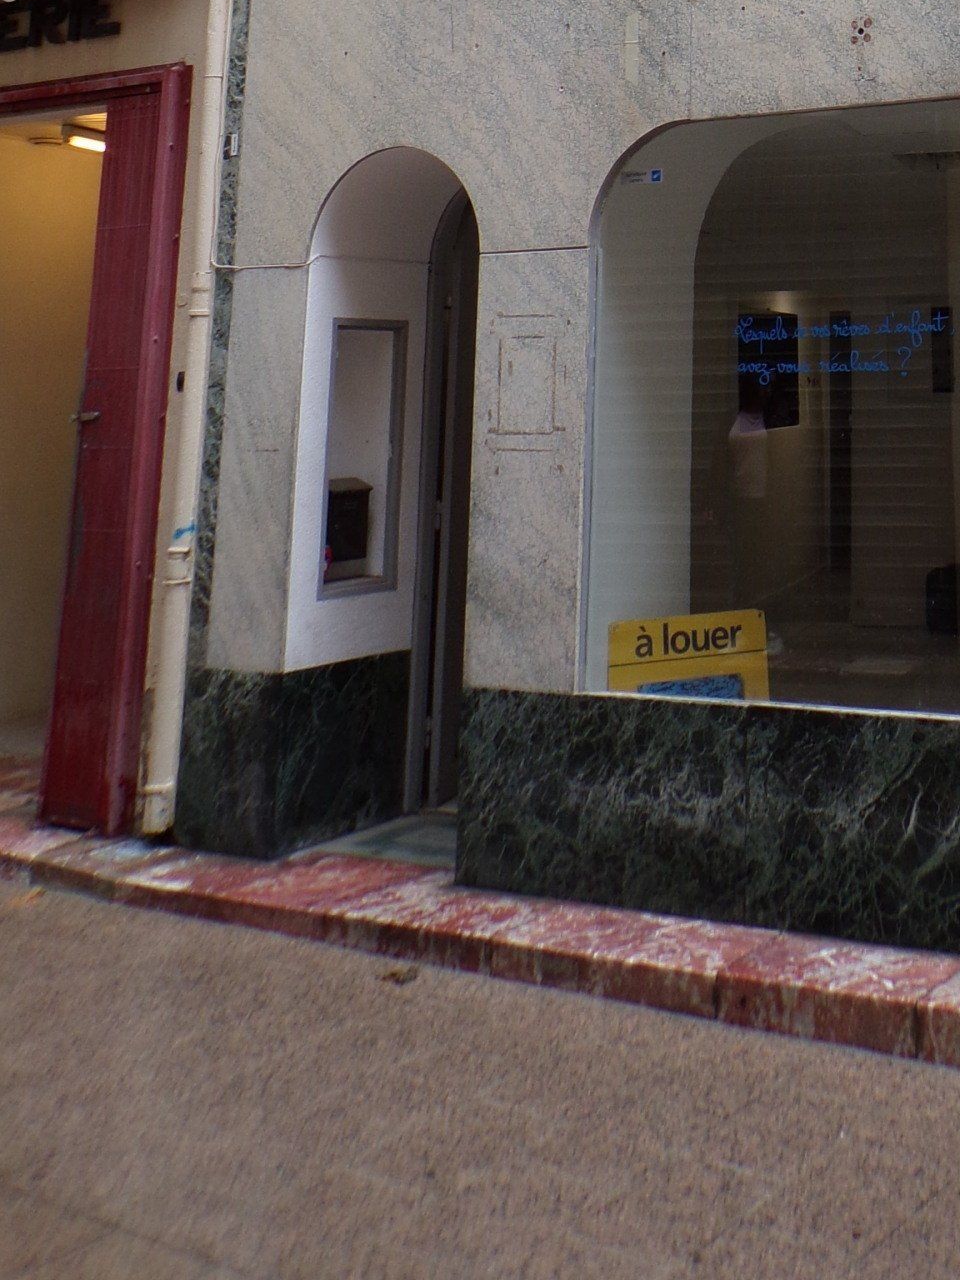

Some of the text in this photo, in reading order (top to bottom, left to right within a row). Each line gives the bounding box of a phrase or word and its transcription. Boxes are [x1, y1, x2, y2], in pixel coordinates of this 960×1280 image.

[733, 315, 788, 354] Lesquels
[635, 622, 742, 658] à louer
